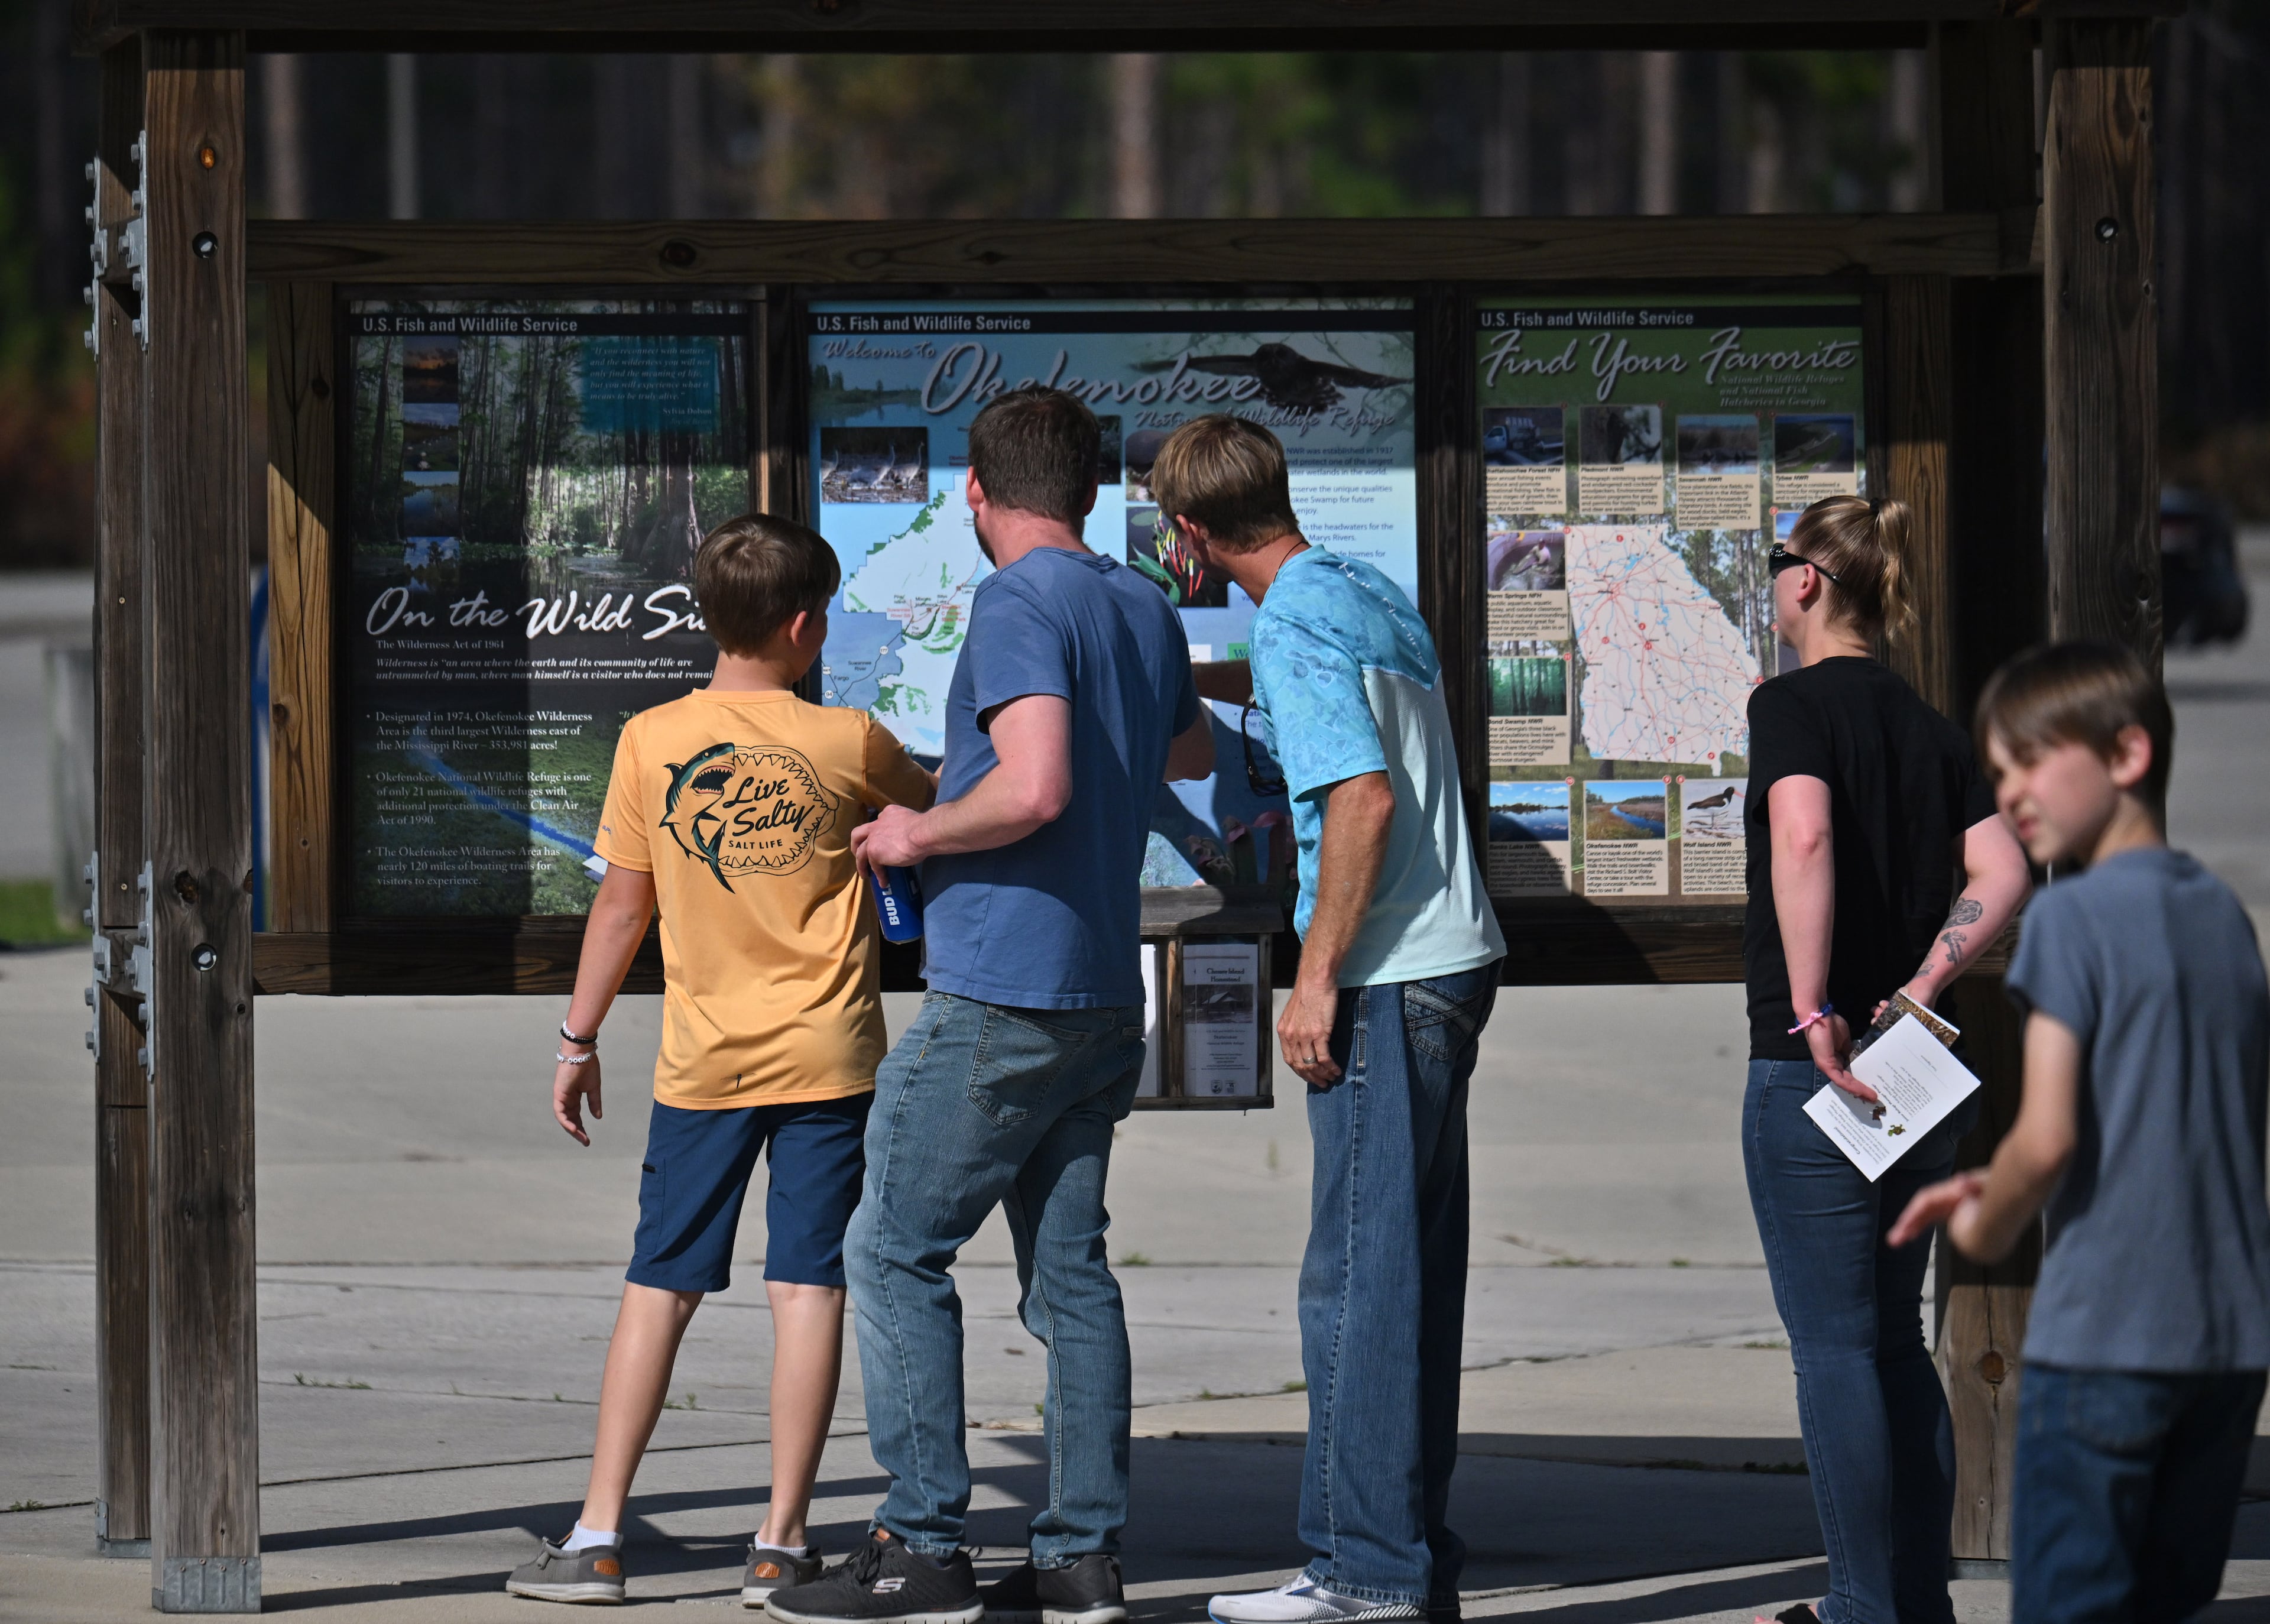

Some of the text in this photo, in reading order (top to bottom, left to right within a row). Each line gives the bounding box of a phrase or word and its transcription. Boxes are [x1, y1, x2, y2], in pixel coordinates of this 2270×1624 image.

[362, 317, 578, 332] U.S. Fish and Wildlife Service
[816, 316, 1031, 331] U.S. Fish and Wildlife Service
[1481, 312, 1694, 326] U.S. Fish and Wildlife Service
[822, 338, 935, 359] Welcome to
[1480, 327, 1859, 403] Find Your Favorite
[1239, 406, 1320, 437] Wildlife
[1327, 404, 1396, 436] Refuge
[1333, 486, 1360, 494] unique
[1361, 486, 1393, 494] qualities
[1311, 497, 1338, 505] Swamp
[1309, 534, 1331, 543] Marys
[366, 585, 707, 641] On the Wild Si
[376, 640, 504, 649] The Wilderness Act of 1964
[377, 658, 427, 667] Wilderness
[430, 658, 438, 667] is
[460, 658, 481, 667] area
[484, 658, 512, 667] where
[514, 658, 530, 667] the
[532, 658, 557, 667] earth
[559, 658, 577, 667] and
[579, 658, 591, 667] its
[594, 658, 647, 669] community
[648, 658, 658, 667] of
[660, 658, 676, 667] life
[677, 658, 693, 667] are
[376, 670, 713, 681] untrammeled by man, where man himself is a visitor who does not remai
[375, 711, 431, 724] Designated
[433, 711, 443, 721] in
[475, 711, 534, 721] Okefenokee
[536, 711, 593, 721] Wilderness
[376, 725, 582, 738] Area is the third largest Wilderness east of
[376, 740, 393, 750] the
[395, 740, 449, 753] Mississippi
[452, 740, 478, 750] River
[530, 740, 558, 750] acres!
[722, 776, 789, 808] Live
[732, 799, 815, 837] Salty
[728, 839, 783, 850] SALT LIFE
[884, 897, 900, 926] BUD
